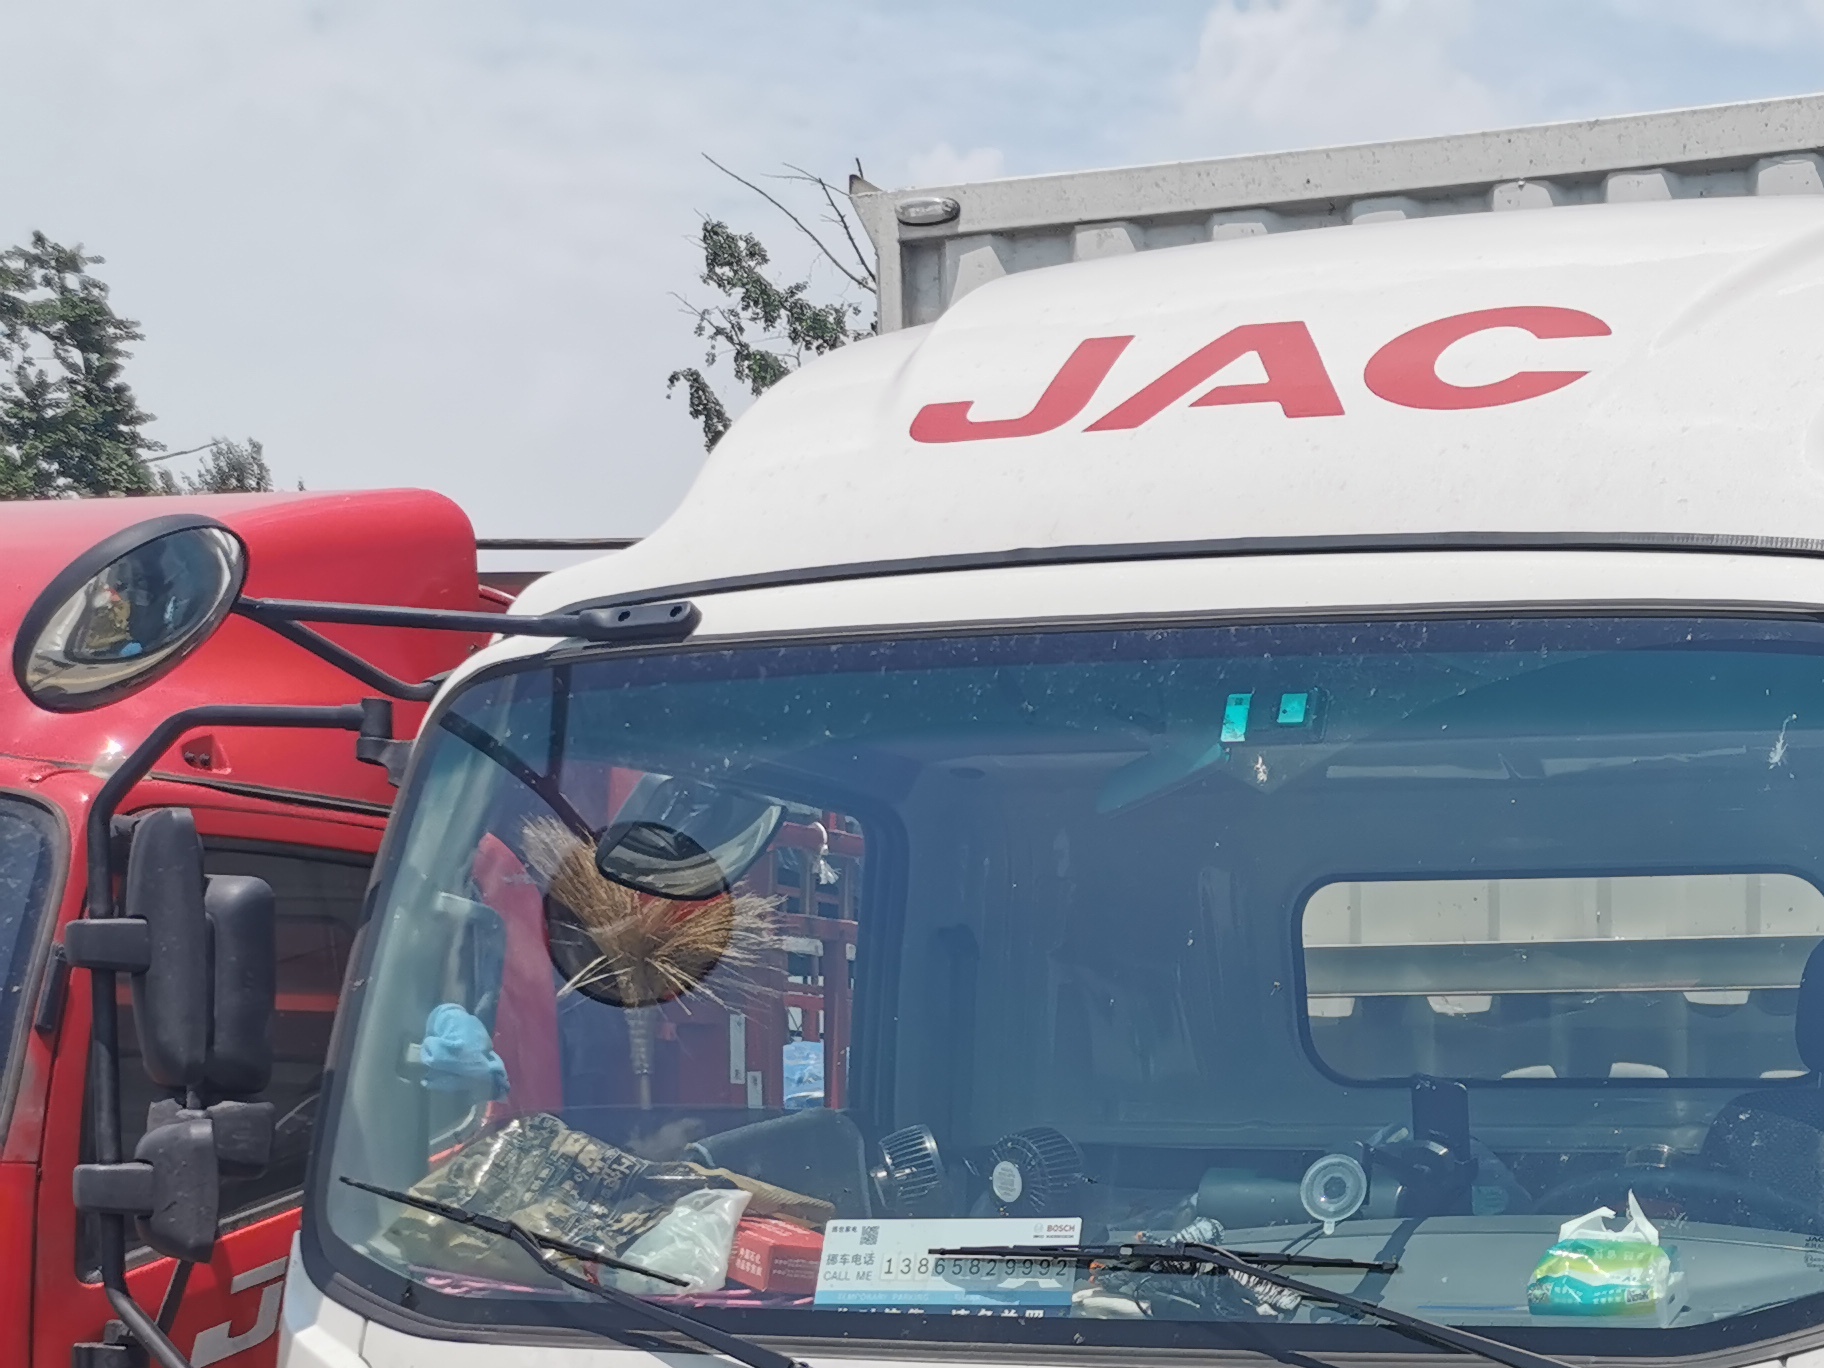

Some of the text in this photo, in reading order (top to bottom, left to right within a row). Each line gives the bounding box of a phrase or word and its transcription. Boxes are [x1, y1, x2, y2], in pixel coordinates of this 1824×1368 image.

[909, 305, 1613, 443] JAC
[1046, 1224, 1076, 1233] BOSCH
[826, 1252, 875, 1266] 挪车电话
[883, 1257, 1068, 1277] 13865829992
[823, 1270, 873, 1282] CALL ME
